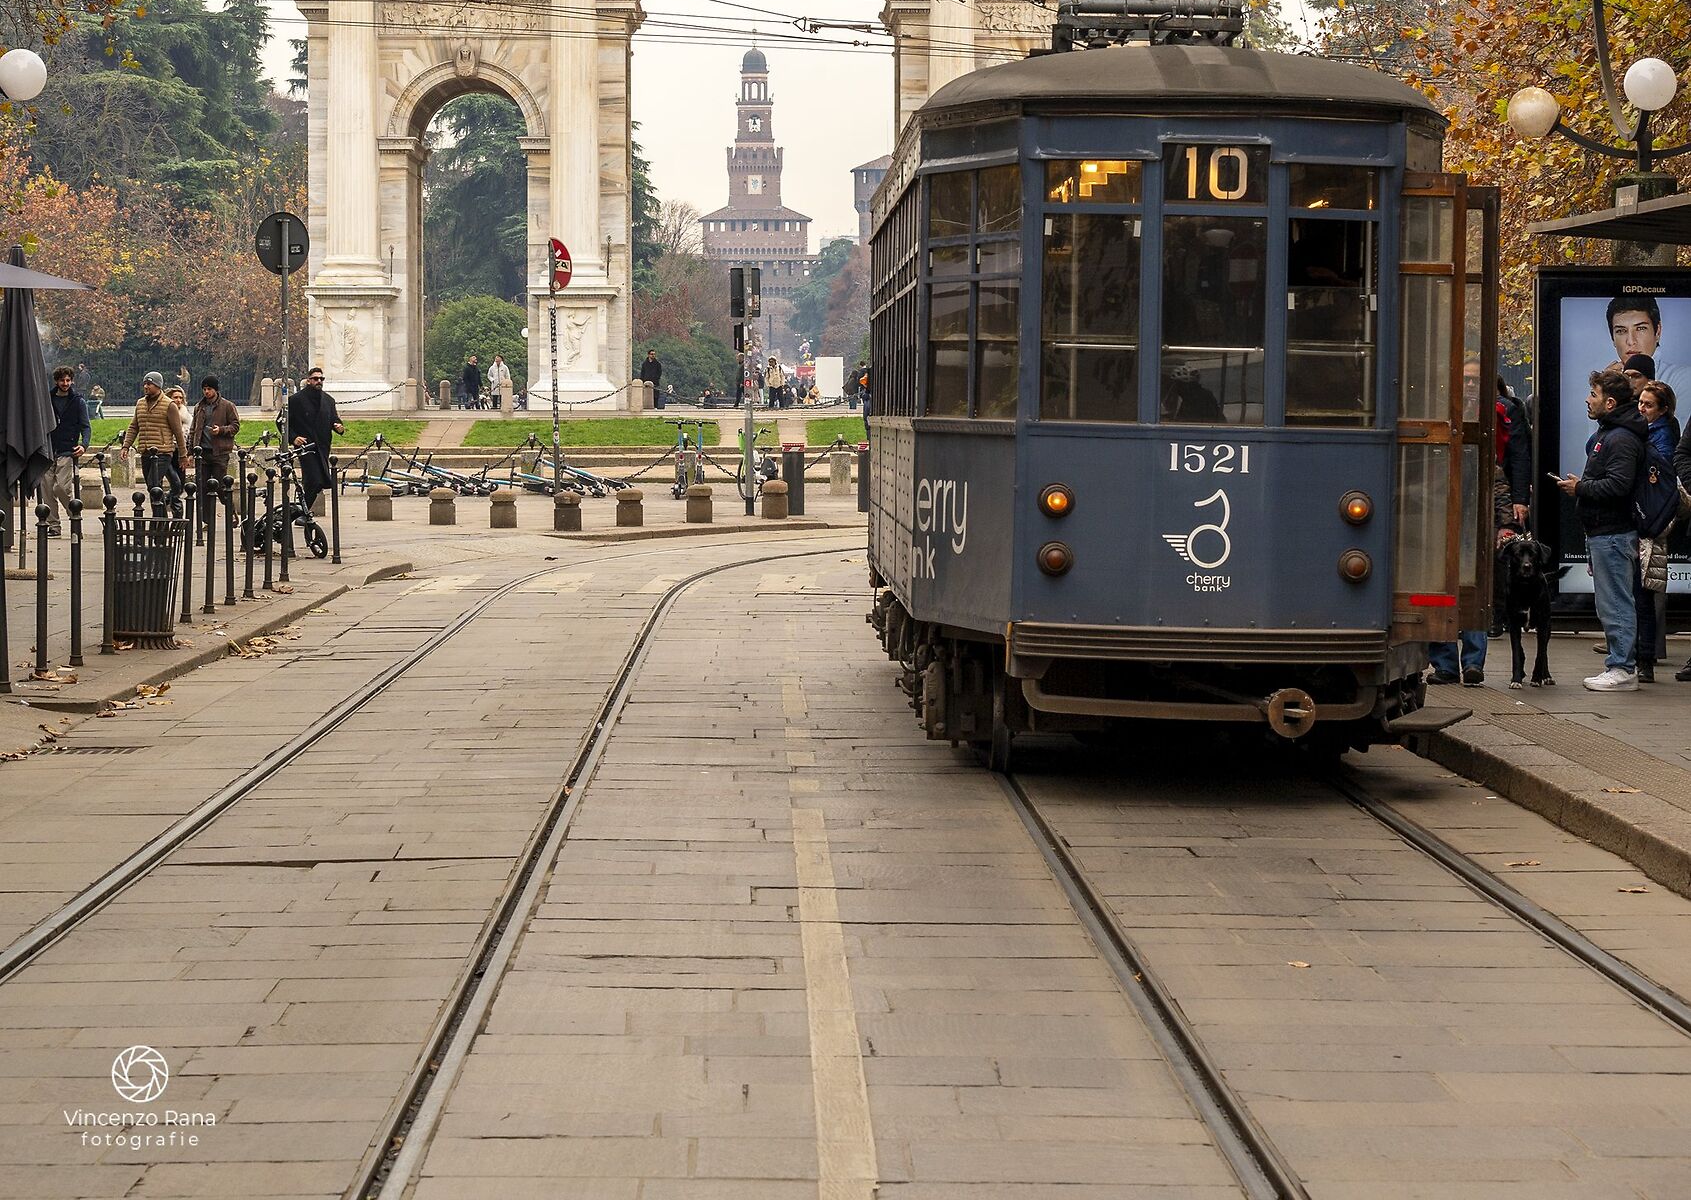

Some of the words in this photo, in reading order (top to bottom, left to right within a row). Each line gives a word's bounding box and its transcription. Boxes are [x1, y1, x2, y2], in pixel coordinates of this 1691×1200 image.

[1186, 147, 1248, 200] 10
[1622, 285, 1666, 293] IGPDecaux
[1169, 443, 1250, 474] 1521
[916, 478, 968, 555] erry
[1186, 572, 1231, 588] cherry
